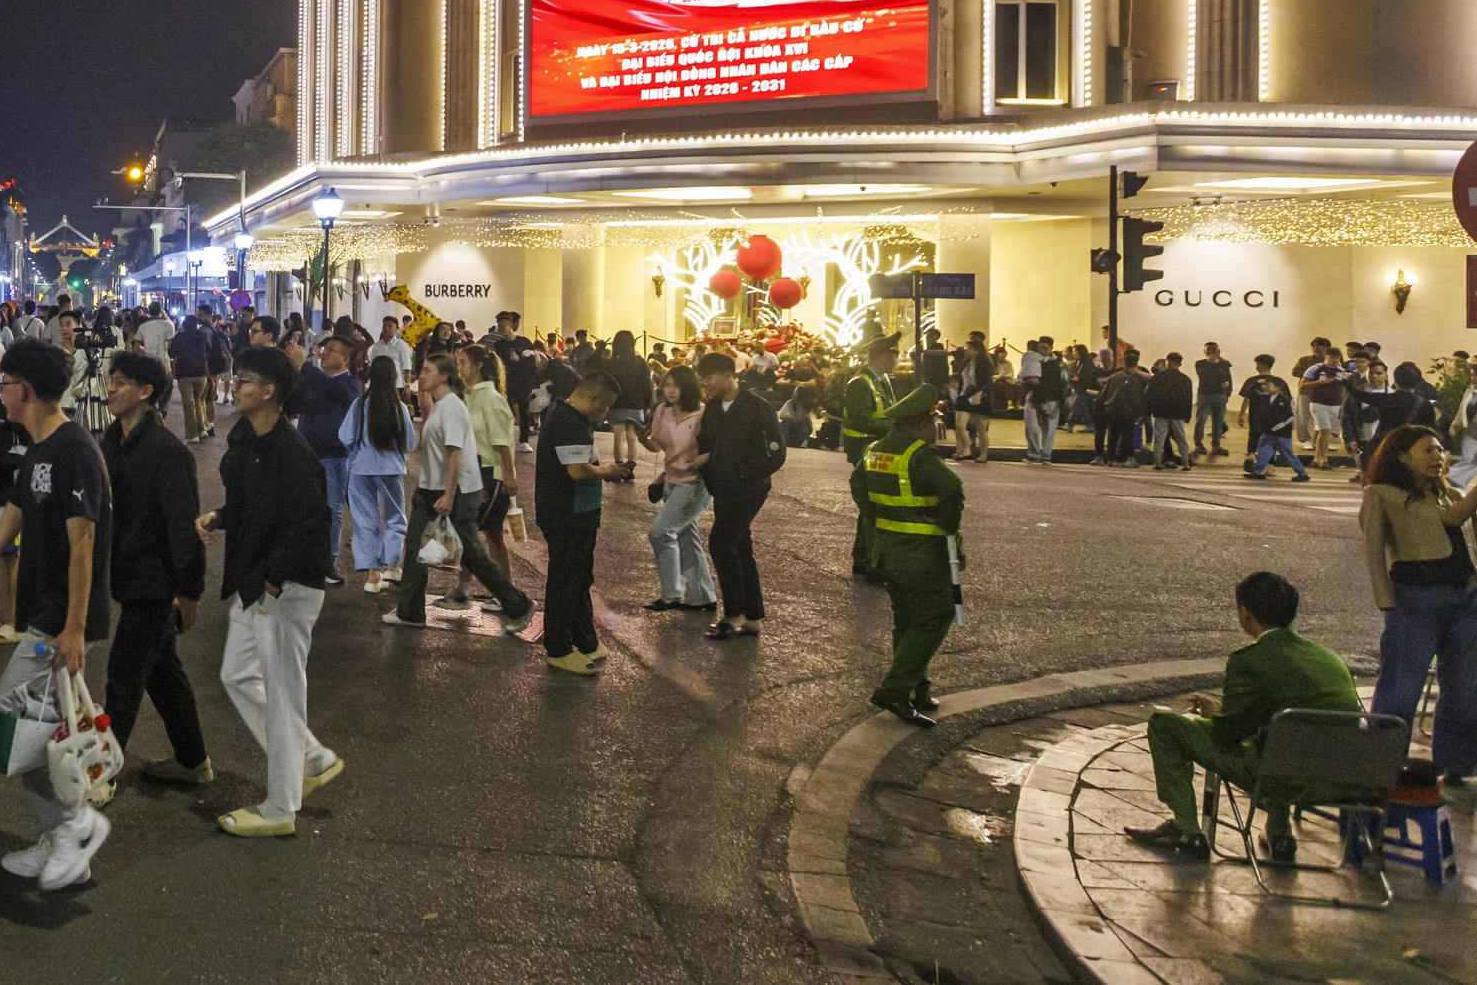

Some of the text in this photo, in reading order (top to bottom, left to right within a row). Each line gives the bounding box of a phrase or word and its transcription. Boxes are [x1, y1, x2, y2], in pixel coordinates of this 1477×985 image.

[702, 33, 724, 47] TRI
[785, 42, 809, 56] XVI
[791, 58, 820, 72] CÁC
[704, 82, 739, 96] 2026
[751, 78, 786, 93] 2031
[425, 284, 491, 298] BURBERRY
[1154, 289, 1279, 308] GUCCI
